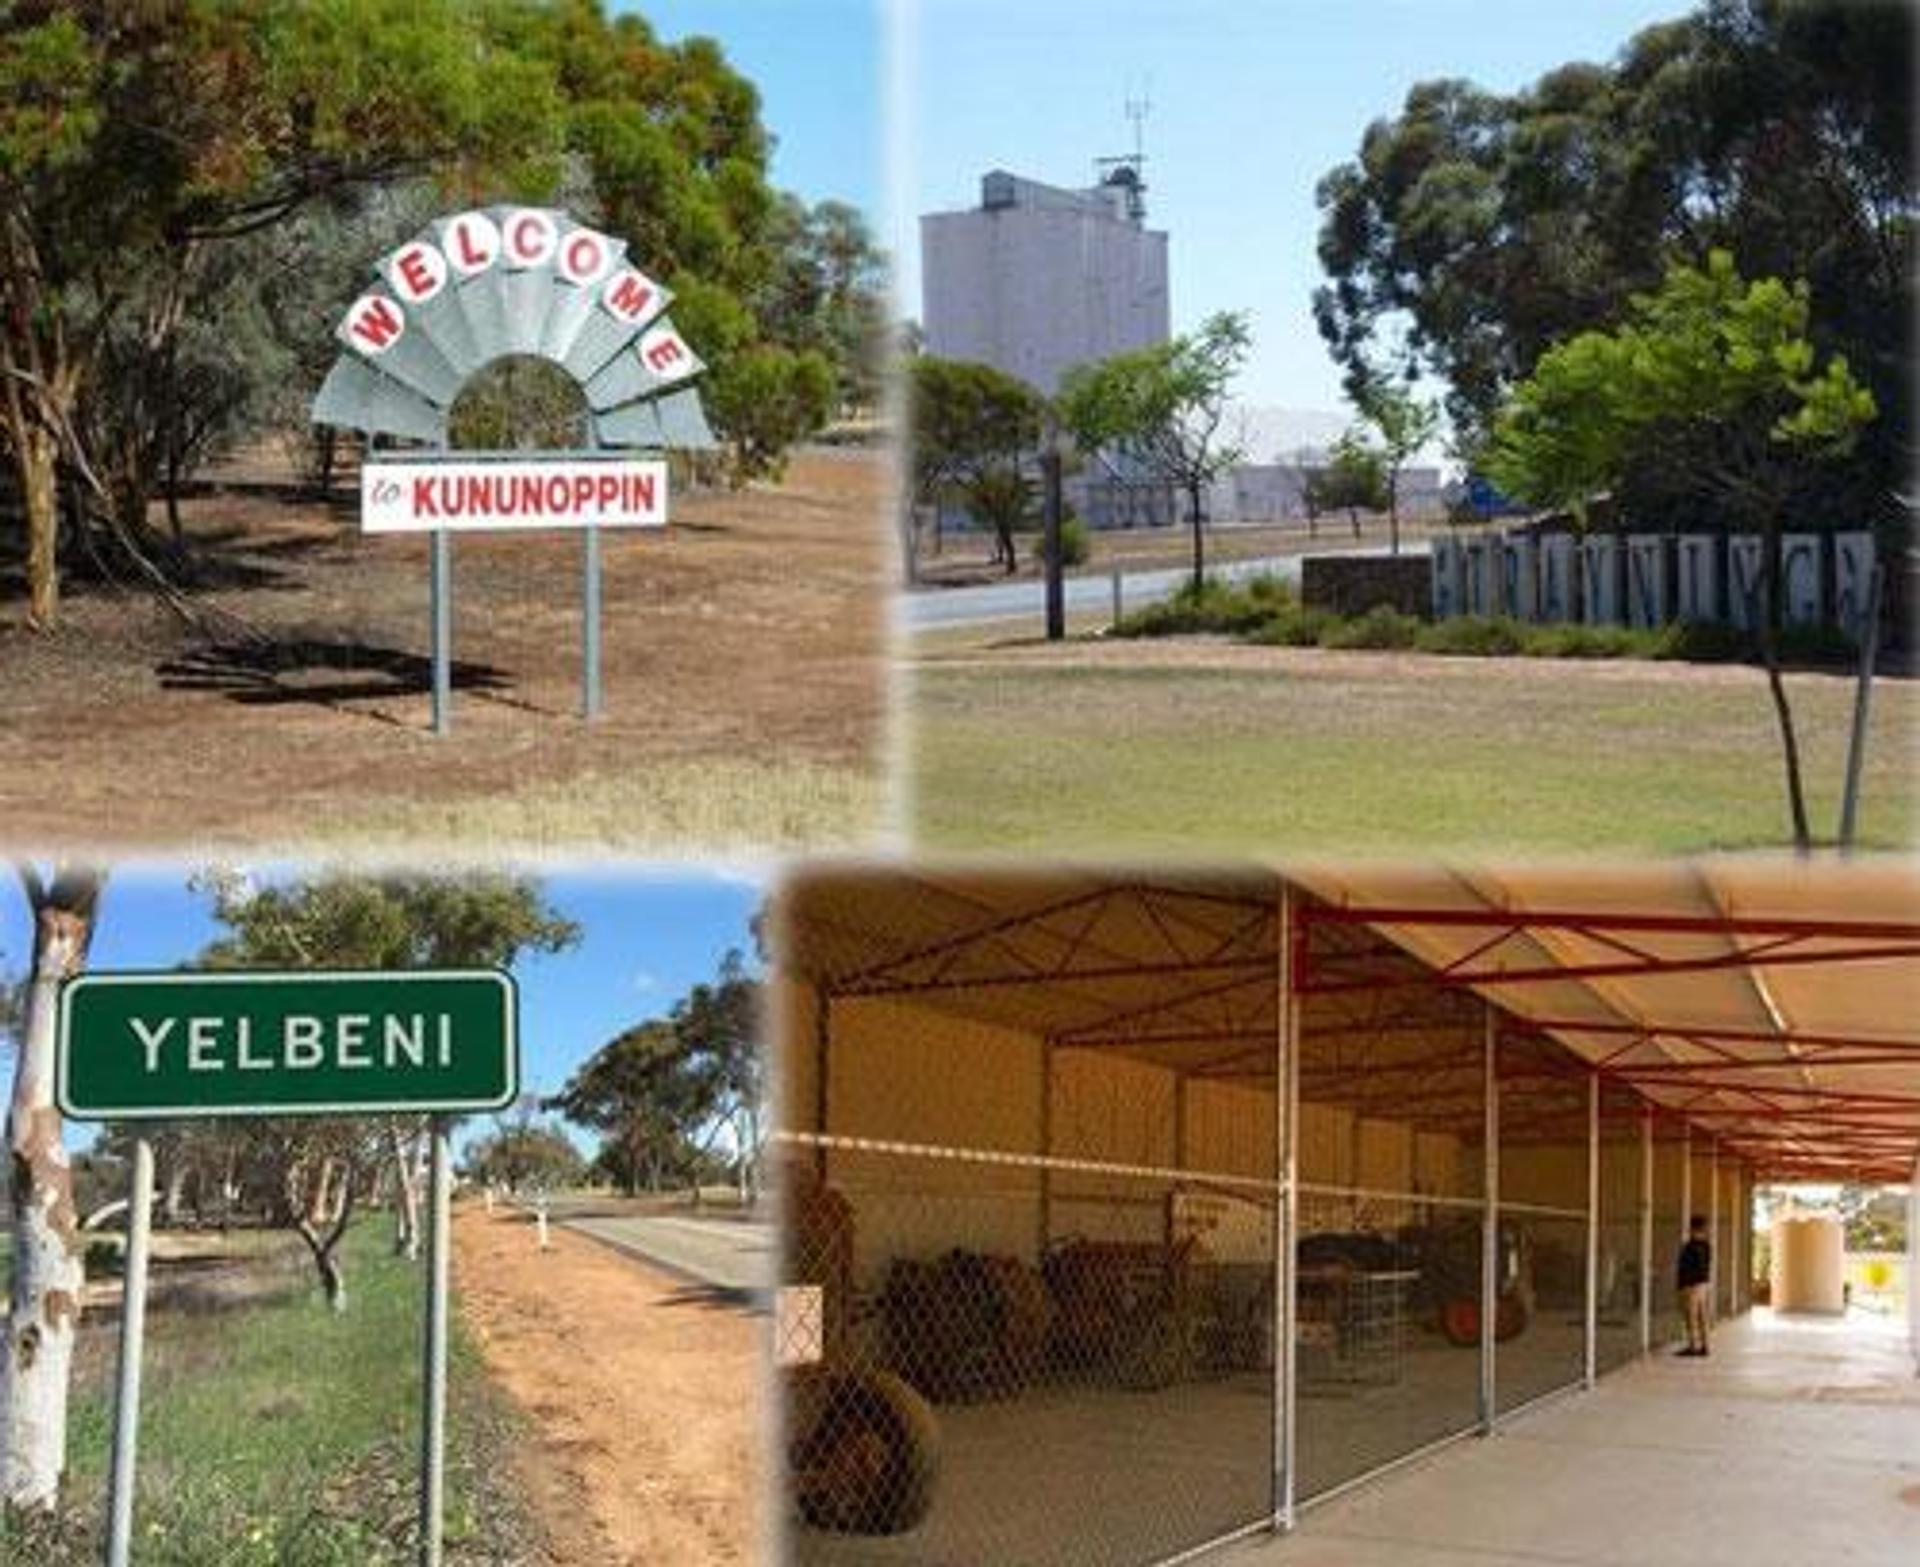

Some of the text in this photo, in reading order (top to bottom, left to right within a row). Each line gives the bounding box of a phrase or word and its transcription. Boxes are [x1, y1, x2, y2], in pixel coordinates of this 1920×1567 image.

[351, 216, 683, 370] WELCOME
[370, 474, 656, 518] to KUNUNOPPIN
[129, 1013, 453, 1073] YELBENI
